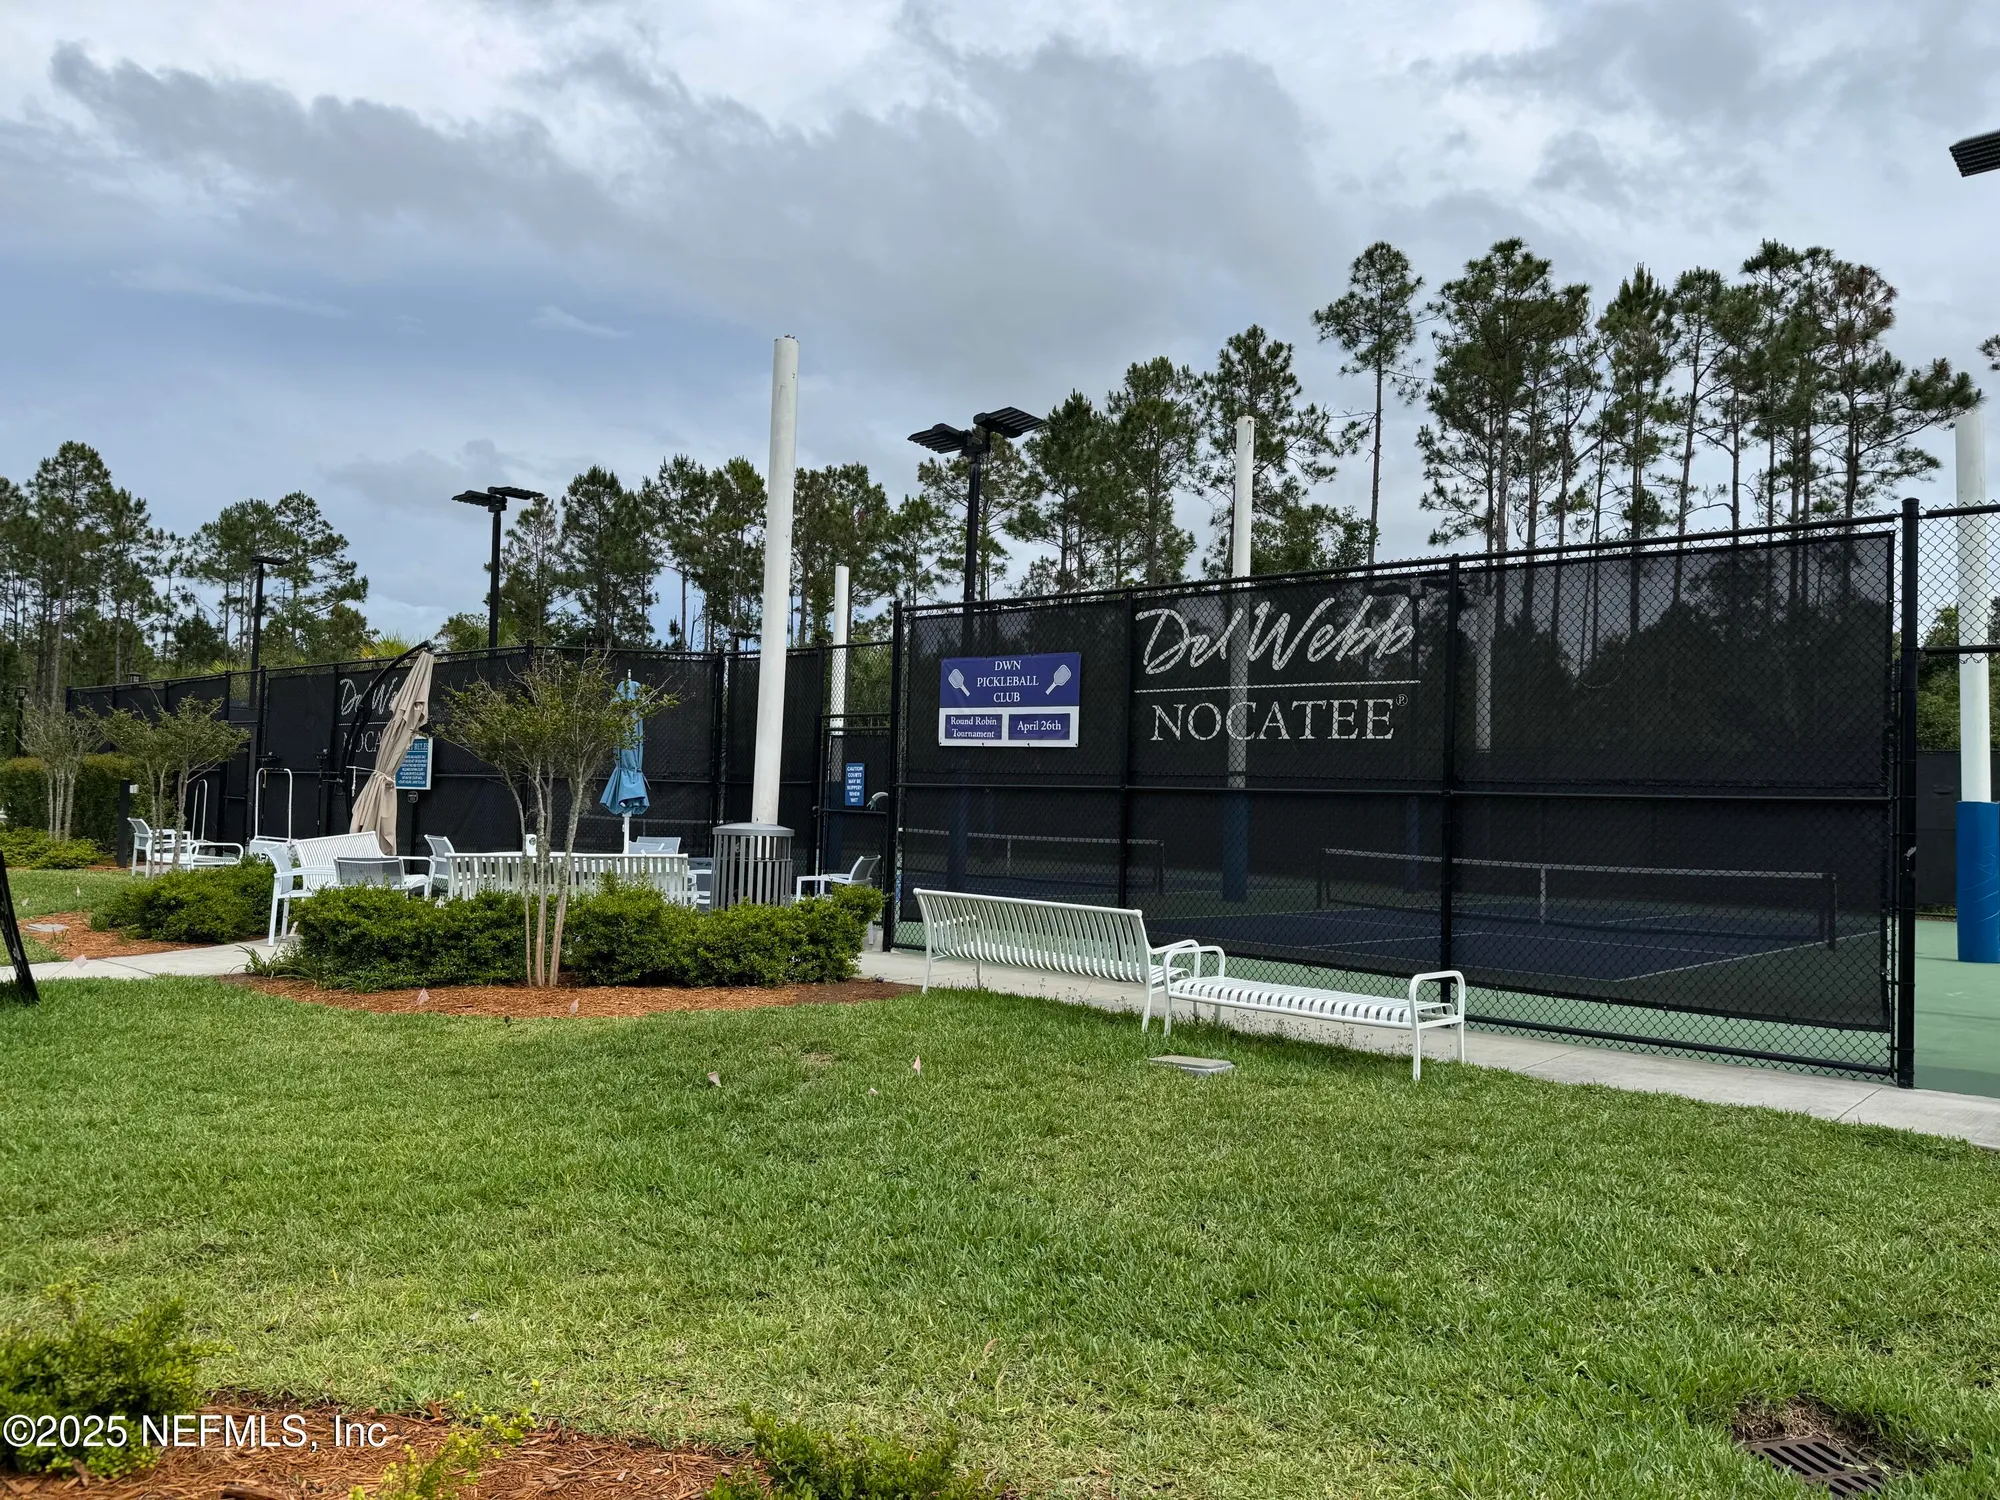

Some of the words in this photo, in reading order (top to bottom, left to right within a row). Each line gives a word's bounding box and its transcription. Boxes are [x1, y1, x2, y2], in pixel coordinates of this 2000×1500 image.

[1135, 607, 1244, 675] Del
[1246, 594, 1416, 671] Webb
[994, 660, 1021, 671] DWN
[976, 675, 1039, 687] PICKLEBALL
[993, 692, 1021, 703] CLUB
[950, 716, 974, 726] Round
[975, 716, 997, 726] Robin
[1150, 698, 1394, 741] NOCATEE
[1017, 720, 1039, 733] April
[1041, 720, 1062, 731] 26th
[952, 728, 995, 739] Tournament
